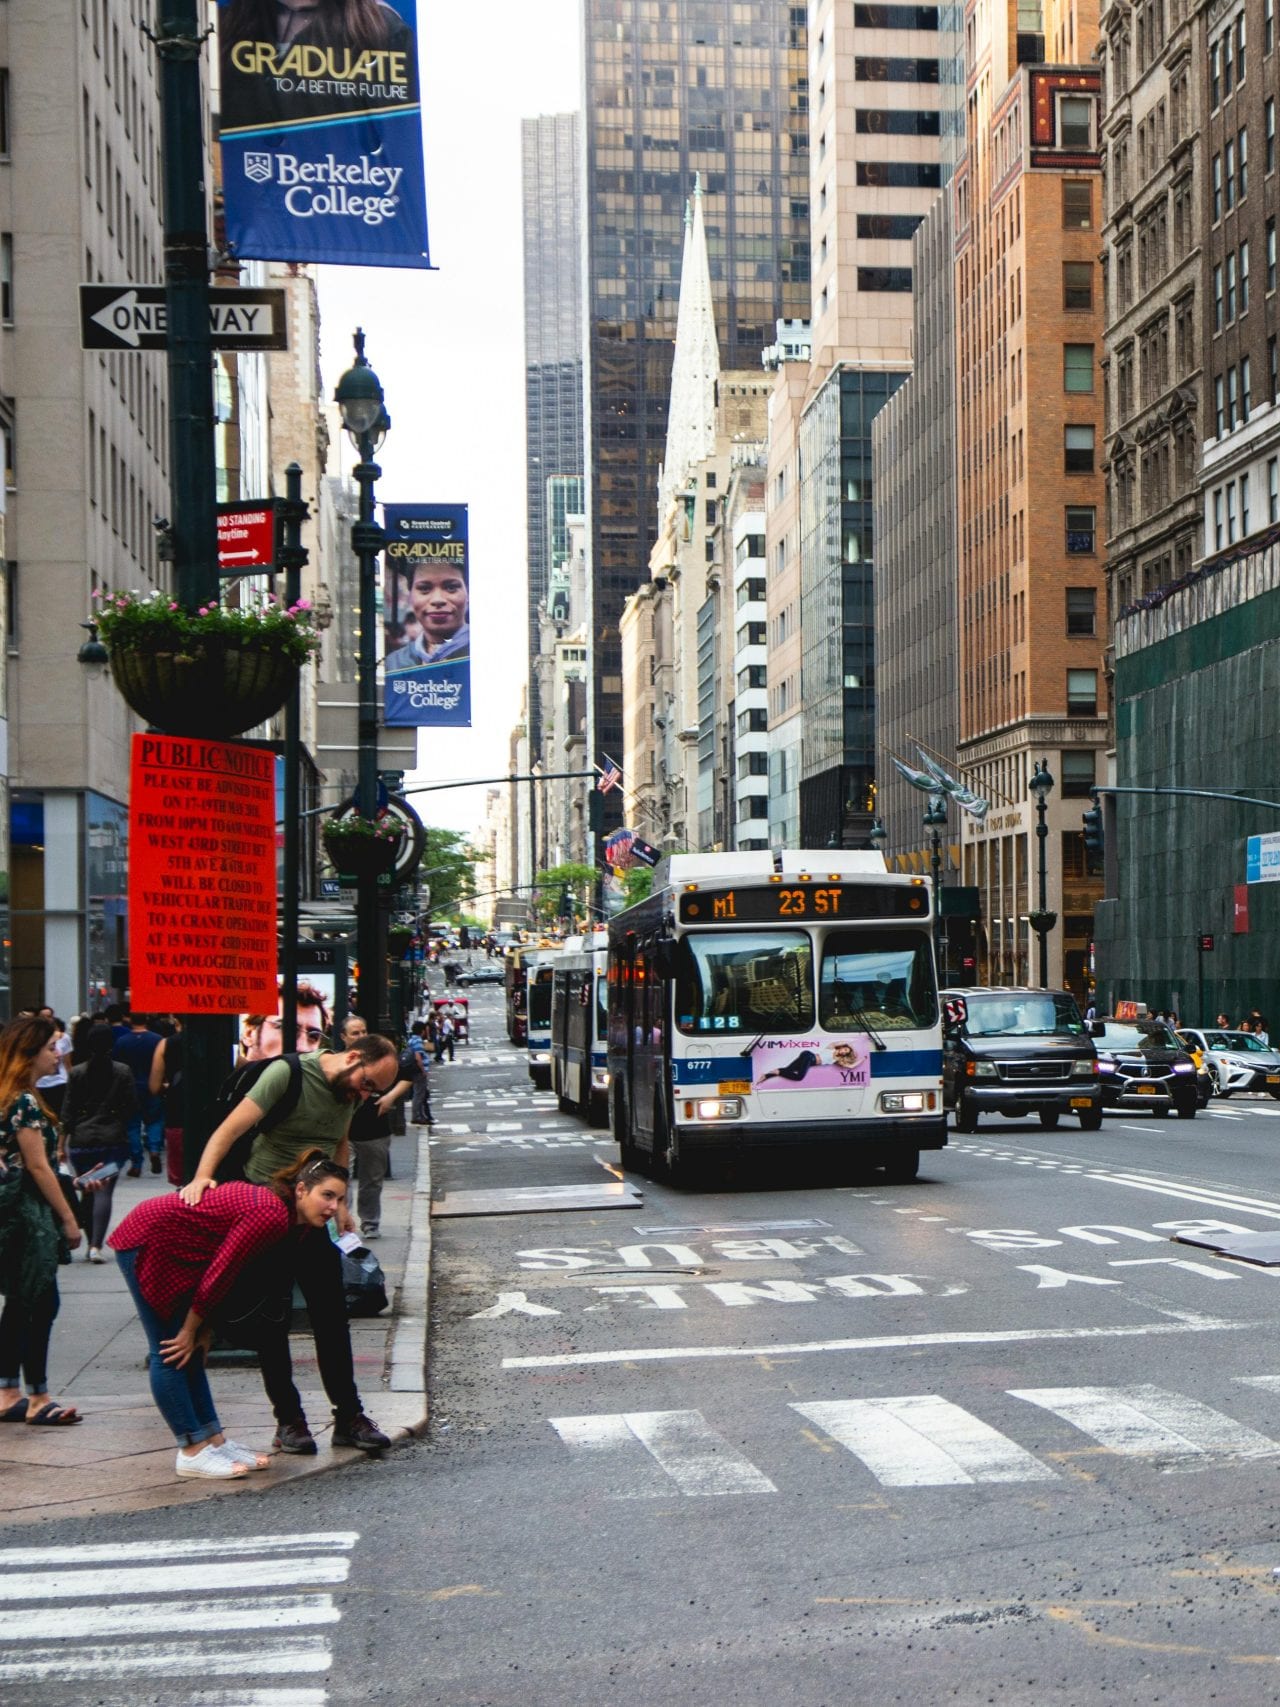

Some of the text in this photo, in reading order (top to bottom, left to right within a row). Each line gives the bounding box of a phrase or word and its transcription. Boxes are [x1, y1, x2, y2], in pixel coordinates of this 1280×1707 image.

[231, 40, 408, 83] GRADUATE
[274, 77, 408, 99] TO A BETTER FUTURE
[275, 154, 403, 195] Berkeley
[217, 512, 266, 527] NO STANDING
[218, 528, 249, 542] Anytime
[388, 543, 464, 557] GRADUATE
[407, 680, 462, 696] Berkeley
[140, 740, 272, 778] PUBLIC NOTICE
[144, 773, 193, 790] PLEASE
[197, 778, 213, 792] BE
[163, 795, 181, 809] ON
[138, 813, 175, 829] FROM
[148, 833, 185, 849] WEST
[160, 874, 195, 890] WILL
[199, 876, 215, 890] BE
[143, 892, 220, 909] VEHICULAR
[778, 890, 805, 914] 23
[814, 889, 842, 913] ST
[147, 912, 166, 926] TO
[180, 914, 224, 930] CRANE
[147, 933, 163, 947] AT
[182, 934, 218, 949] WEST
[145, 952, 167, 966] WE
[171, 953, 238, 970] APOLOGIZE
[188, 993, 215, 1008] MAY
[700, 1016, 740, 1029] 128
[687, 1061, 712, 1070] 6777
